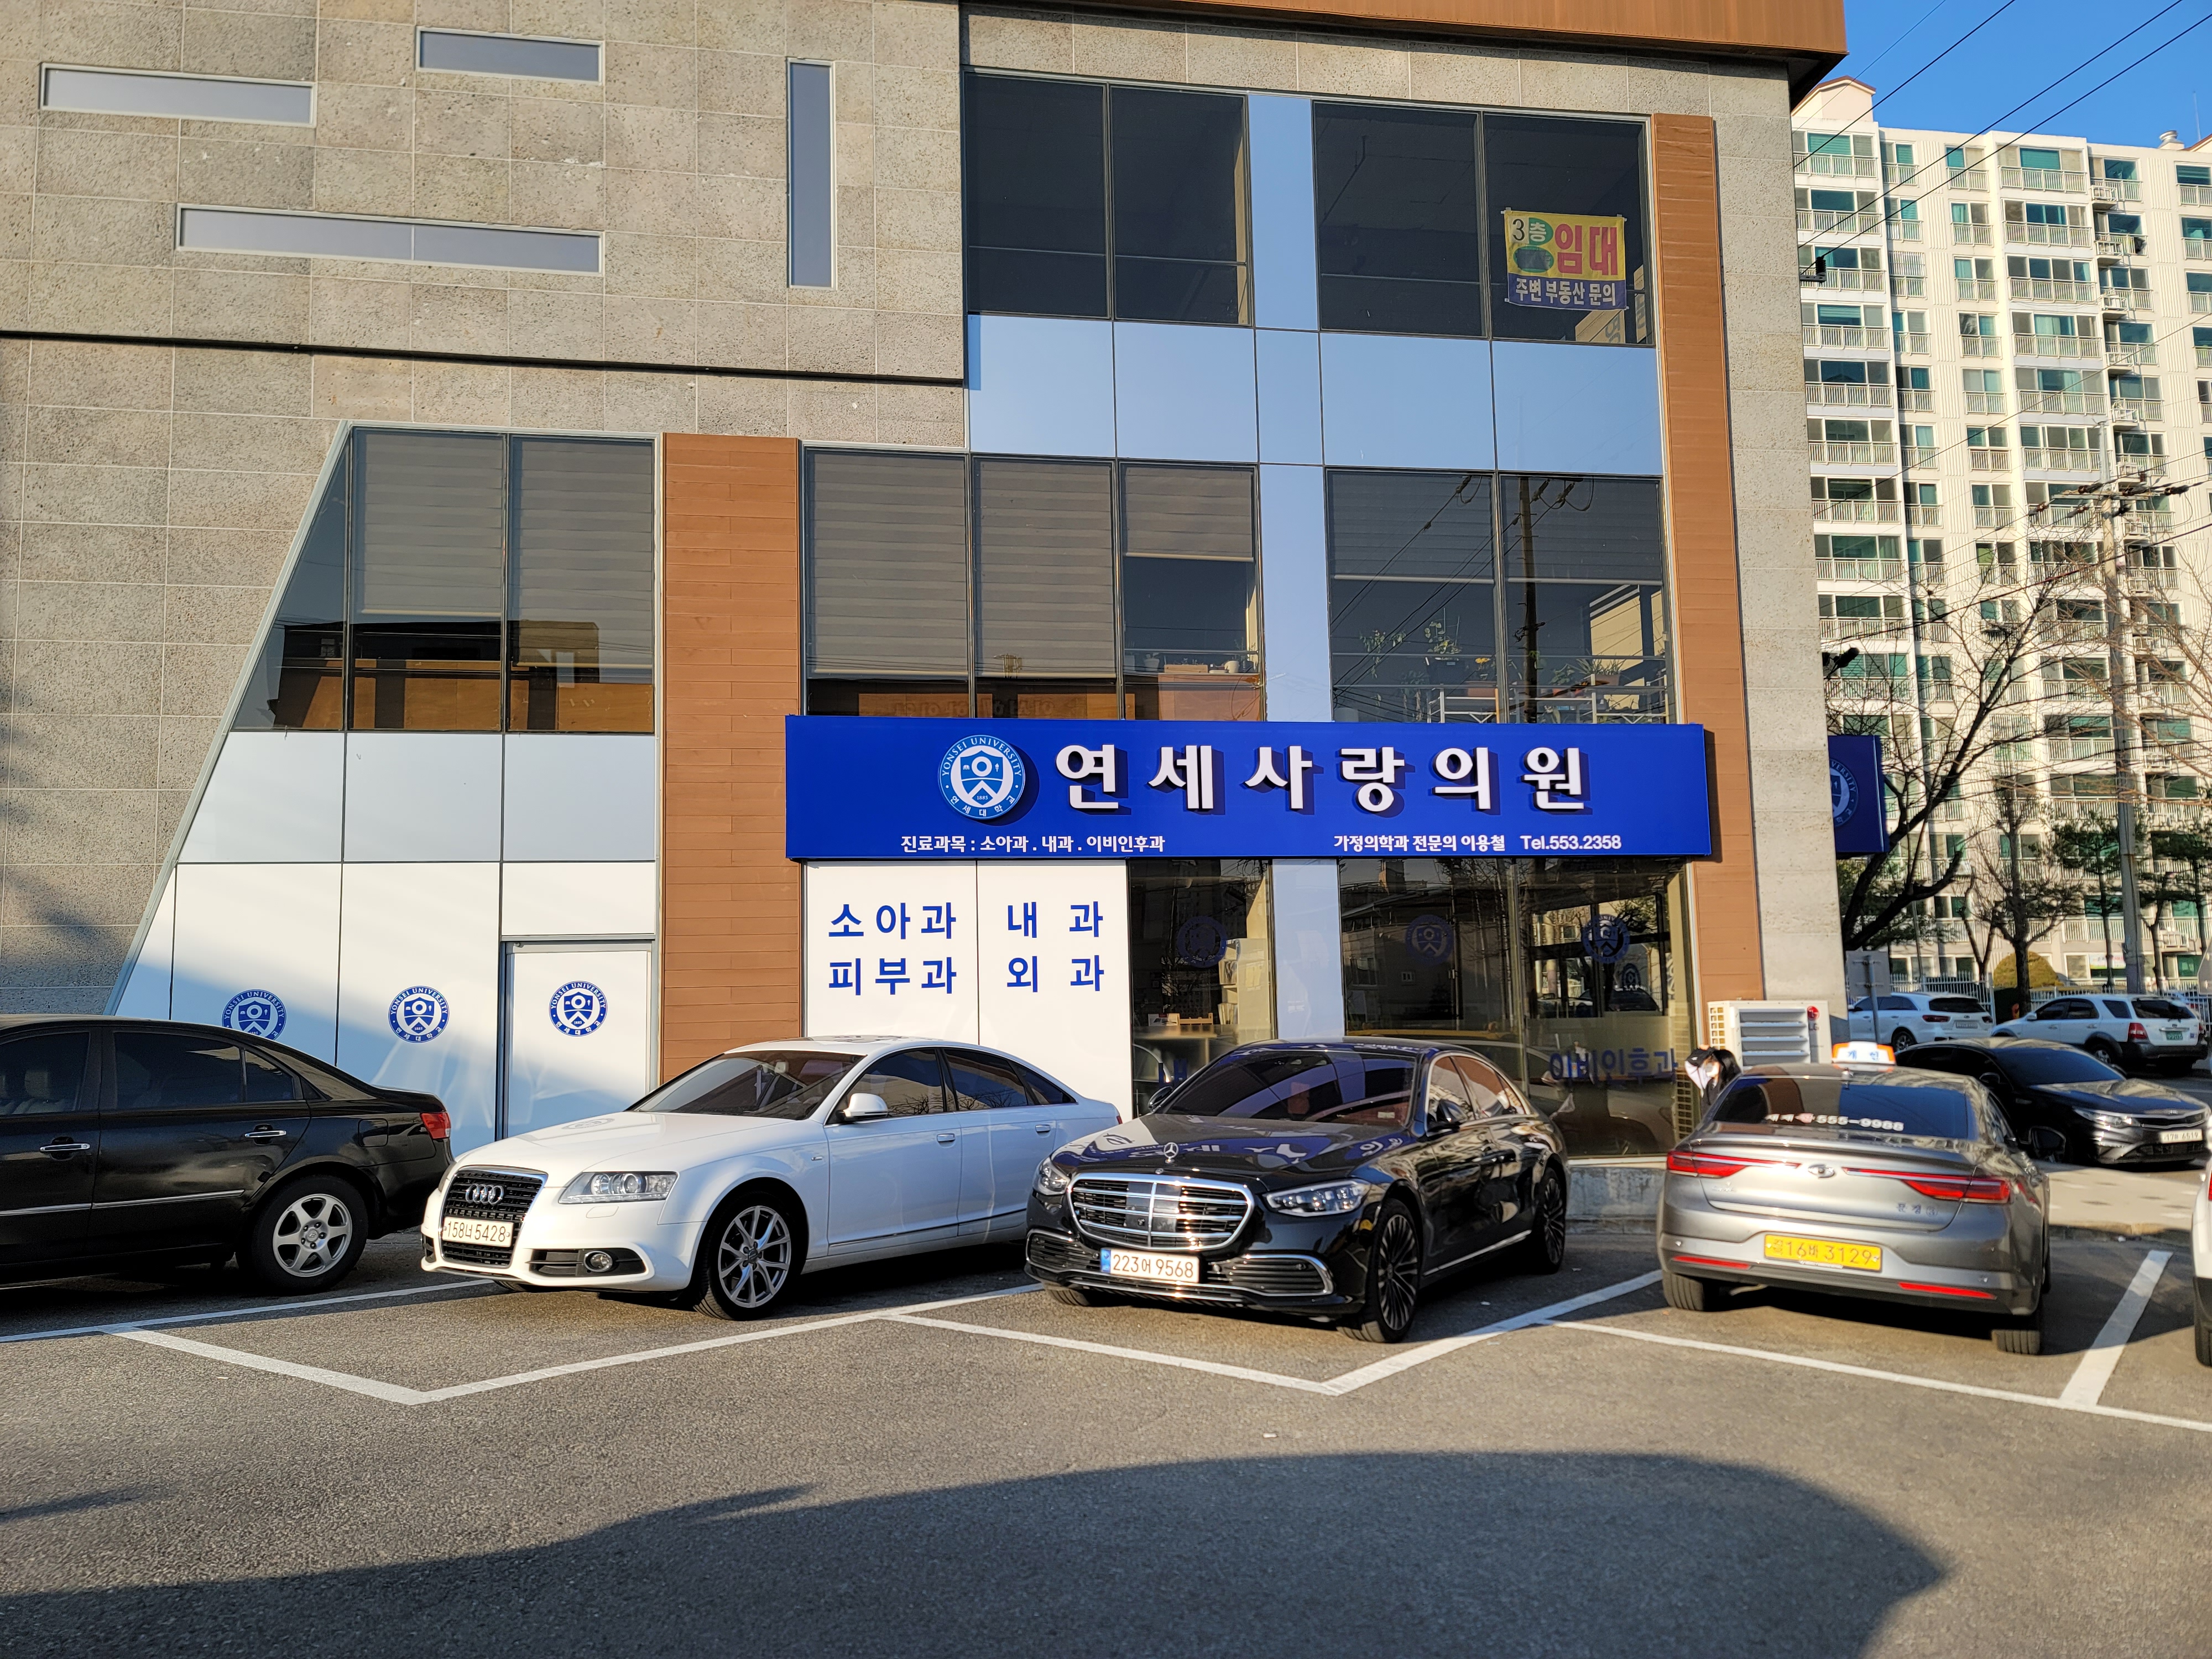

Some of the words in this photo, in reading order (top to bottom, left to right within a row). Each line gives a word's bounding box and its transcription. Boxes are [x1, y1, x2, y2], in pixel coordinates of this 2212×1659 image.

[1554, 223, 1619, 275] 임대
[1515, 278, 1542, 302] 주변
[1546, 280, 1585, 305] 부동산
[1589, 283, 1616, 306] 문의
[942, 741, 967, 776] YONSEI
[970, 737, 1022, 776] UNIVERSITY
[1056, 744, 1584, 812] 연세사랑의원
[1832, 761, 1856, 792] VERSITY
[950, 795, 1015, 817] 연세대학교
[900, 836, 967, 853] 진료과목
[980, 836, 1029, 853] 소아과
[1042, 836, 1074, 853] 내과
[1086, 836, 1166, 852] 이비인후과
[1333, 834, 1410, 852] 가정의학과
[1412, 835, 1457, 852] 전문의
[1460, 834, 1505, 852] 이용철
[1520, 834, 1622, 850] Tel.553.2358
[829, 902, 956, 939] 소아과
[829, 957, 956, 995] 피부과
[225, 995, 244, 1020] YONSEI
[247, 991, 284, 1018] UNIVERSITY
[390, 990, 410, 1015] YONSEI
[412, 988, 448, 1014] UNIVERSITY
[551, 985, 569, 1009] YONSEI
[571, 983, 606, 1008] UNIVERSITY
[1156, 1258, 1194, 1279] 9568
[1824, 1245, 1872, 1265] 3129
